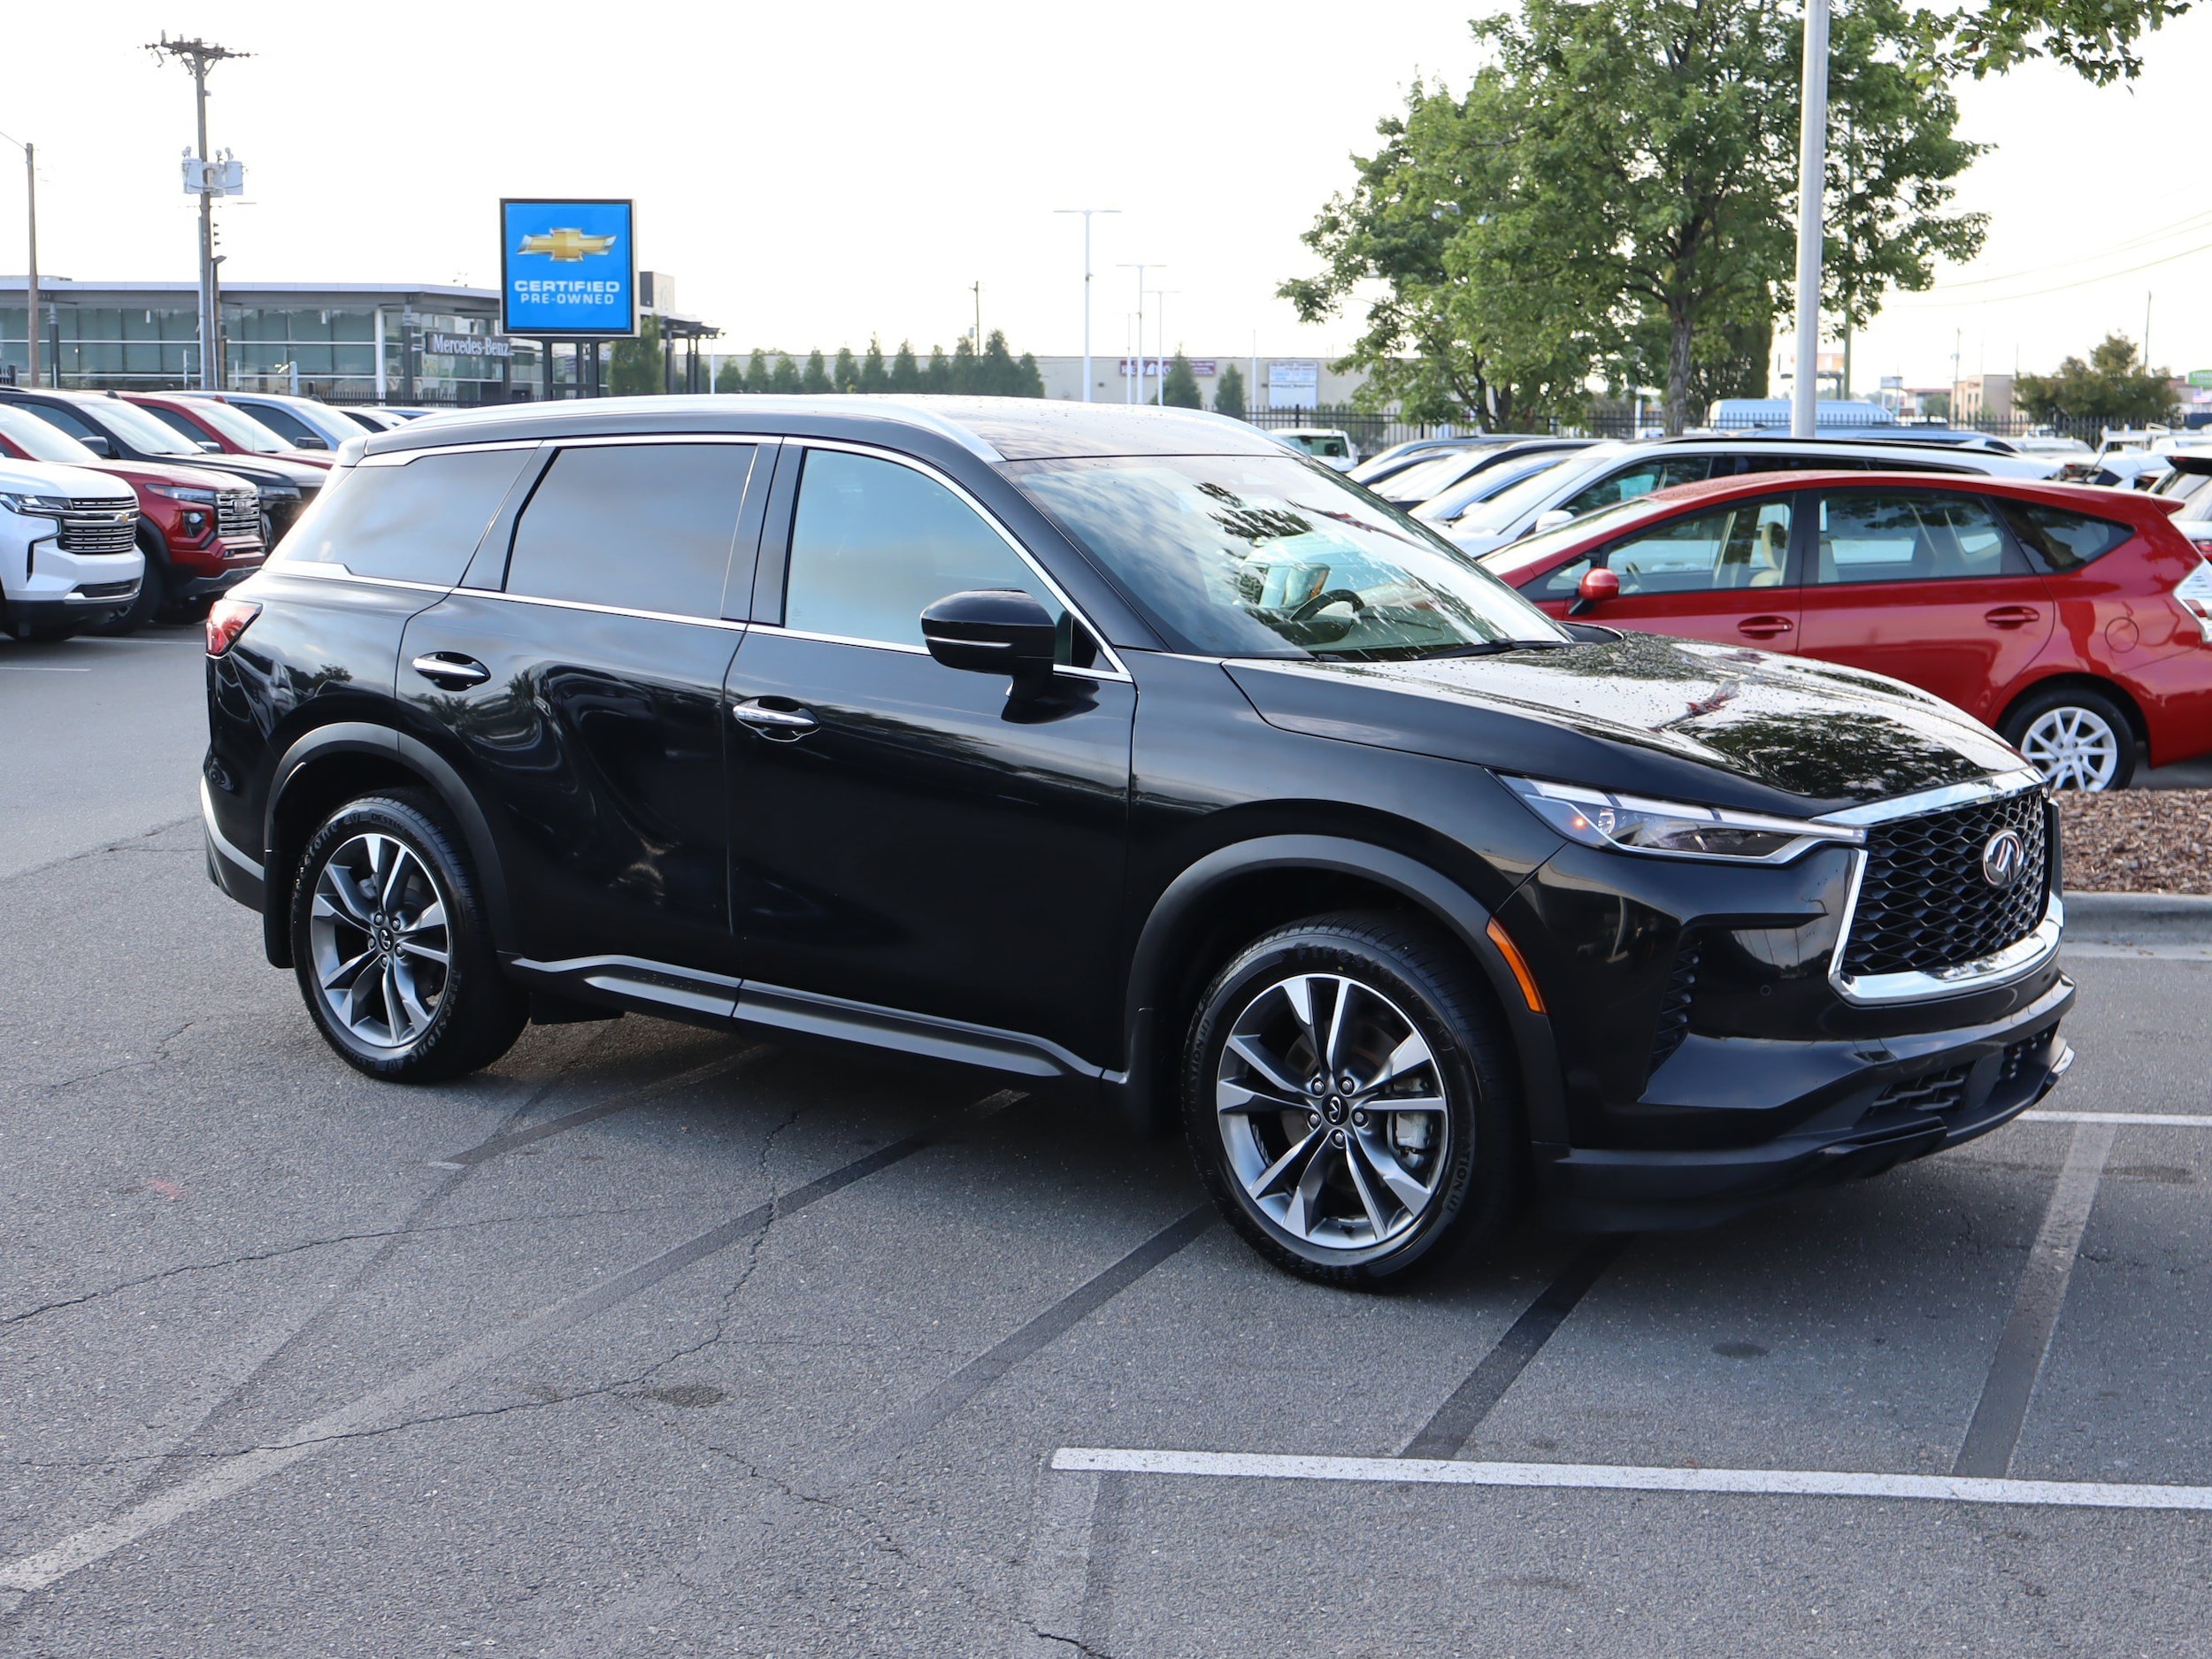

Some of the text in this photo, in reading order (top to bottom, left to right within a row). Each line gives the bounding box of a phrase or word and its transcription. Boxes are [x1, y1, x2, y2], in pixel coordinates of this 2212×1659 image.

[514, 280, 620, 293] CERTIFIED
[520, 293, 615, 305] PRE-OWNED
[434, 334, 510, 357] Mercedes-Benz
